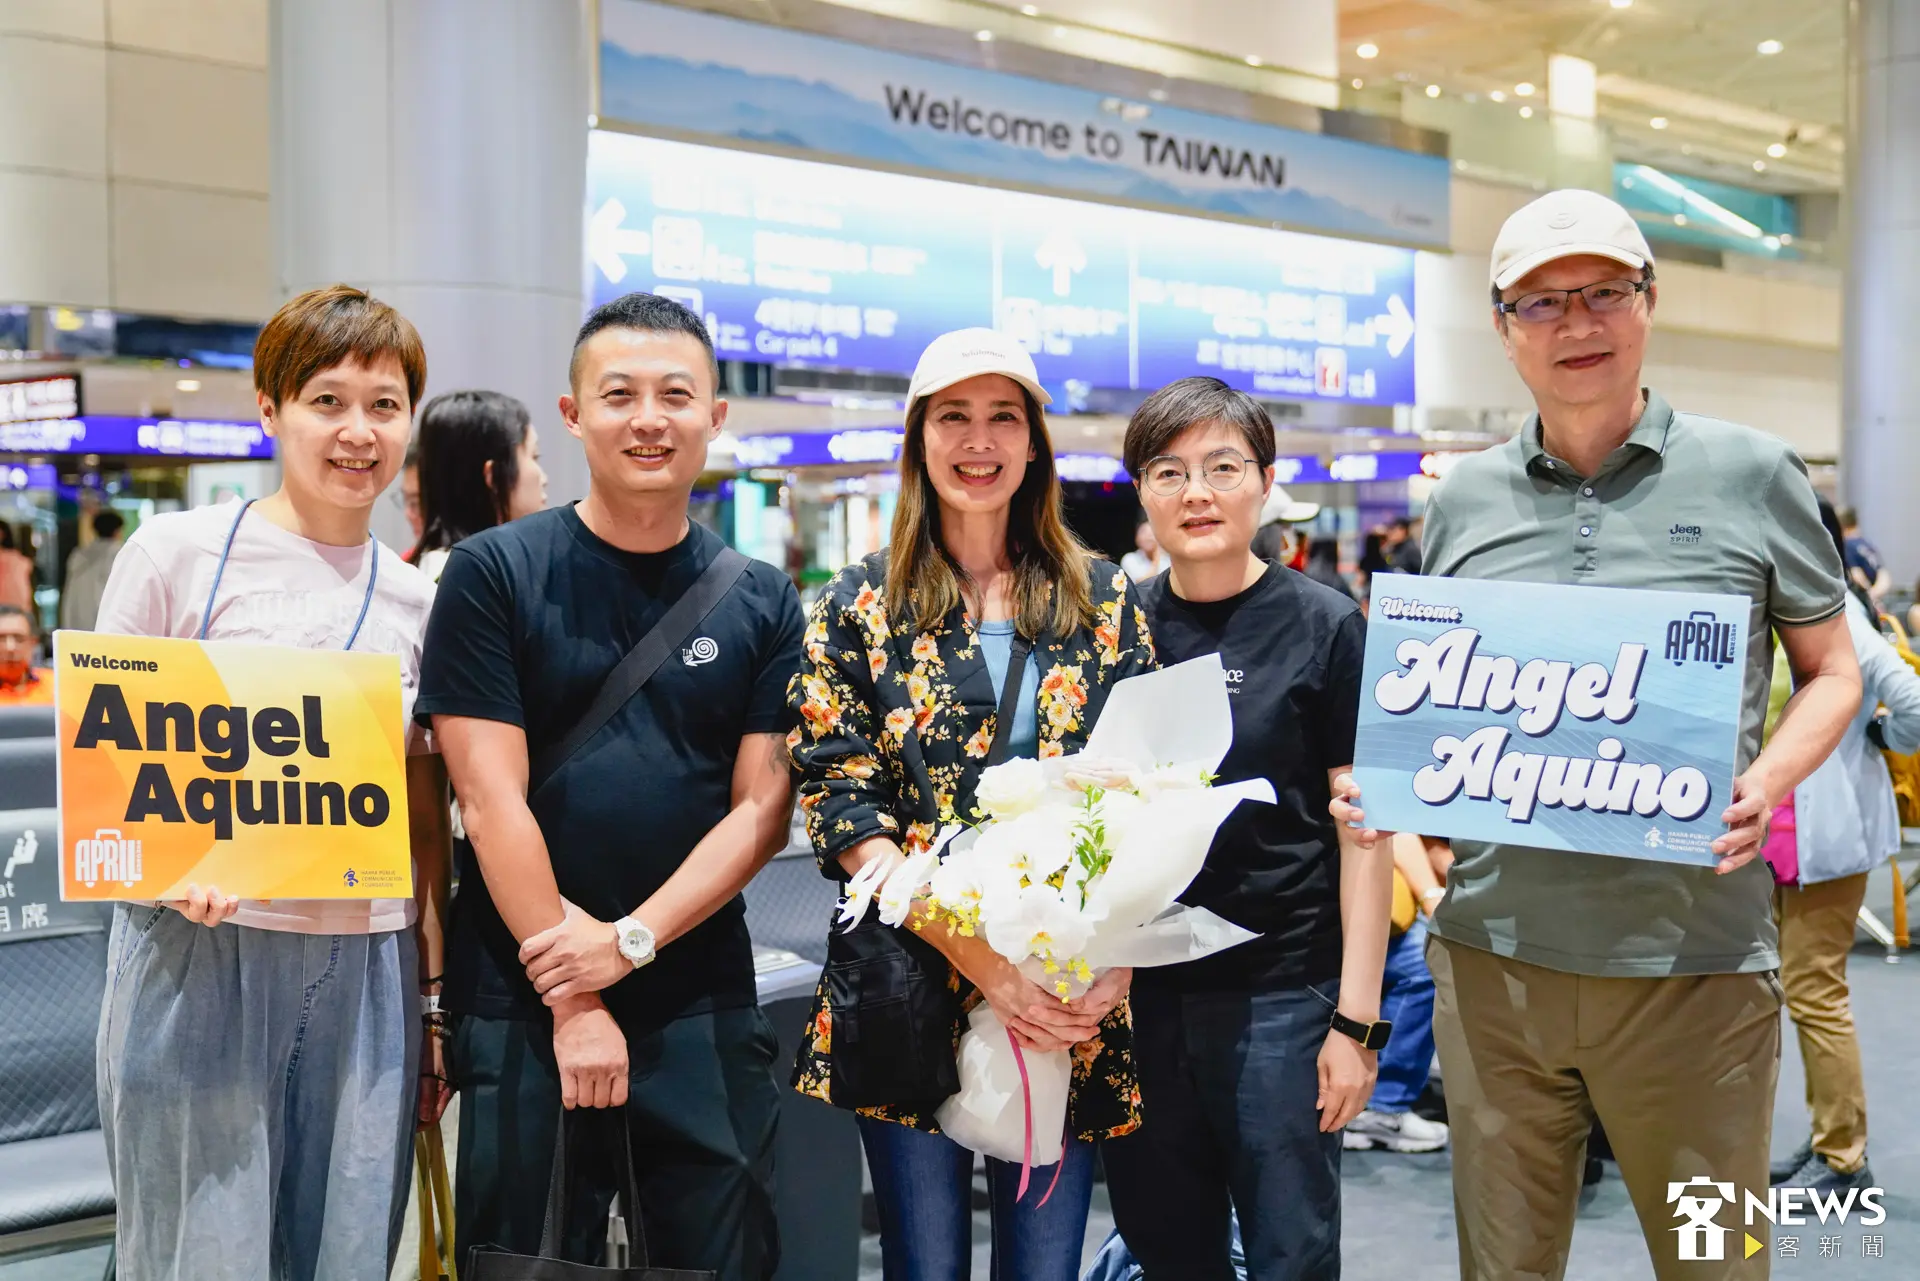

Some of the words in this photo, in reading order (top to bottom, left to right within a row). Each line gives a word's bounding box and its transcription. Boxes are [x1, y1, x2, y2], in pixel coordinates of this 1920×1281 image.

[883, 84, 1071, 151] Welcome
[1085, 124, 1123, 160] to
[1137, 130, 1287, 187] TAIWAN
[1670, 524, 1701, 536] Jeep
[1379, 596, 1463, 624] Welcome
[70, 652, 159, 673] Welcome
[1664, 619, 1735, 664] APRIL
[1374, 627, 1648, 738] Angel
[73, 683, 330, 773] Angel
[124, 763, 390, 841] Aquino
[1412, 725, 1712, 825] Aquino
[75, 838, 143, 882] APRIL
